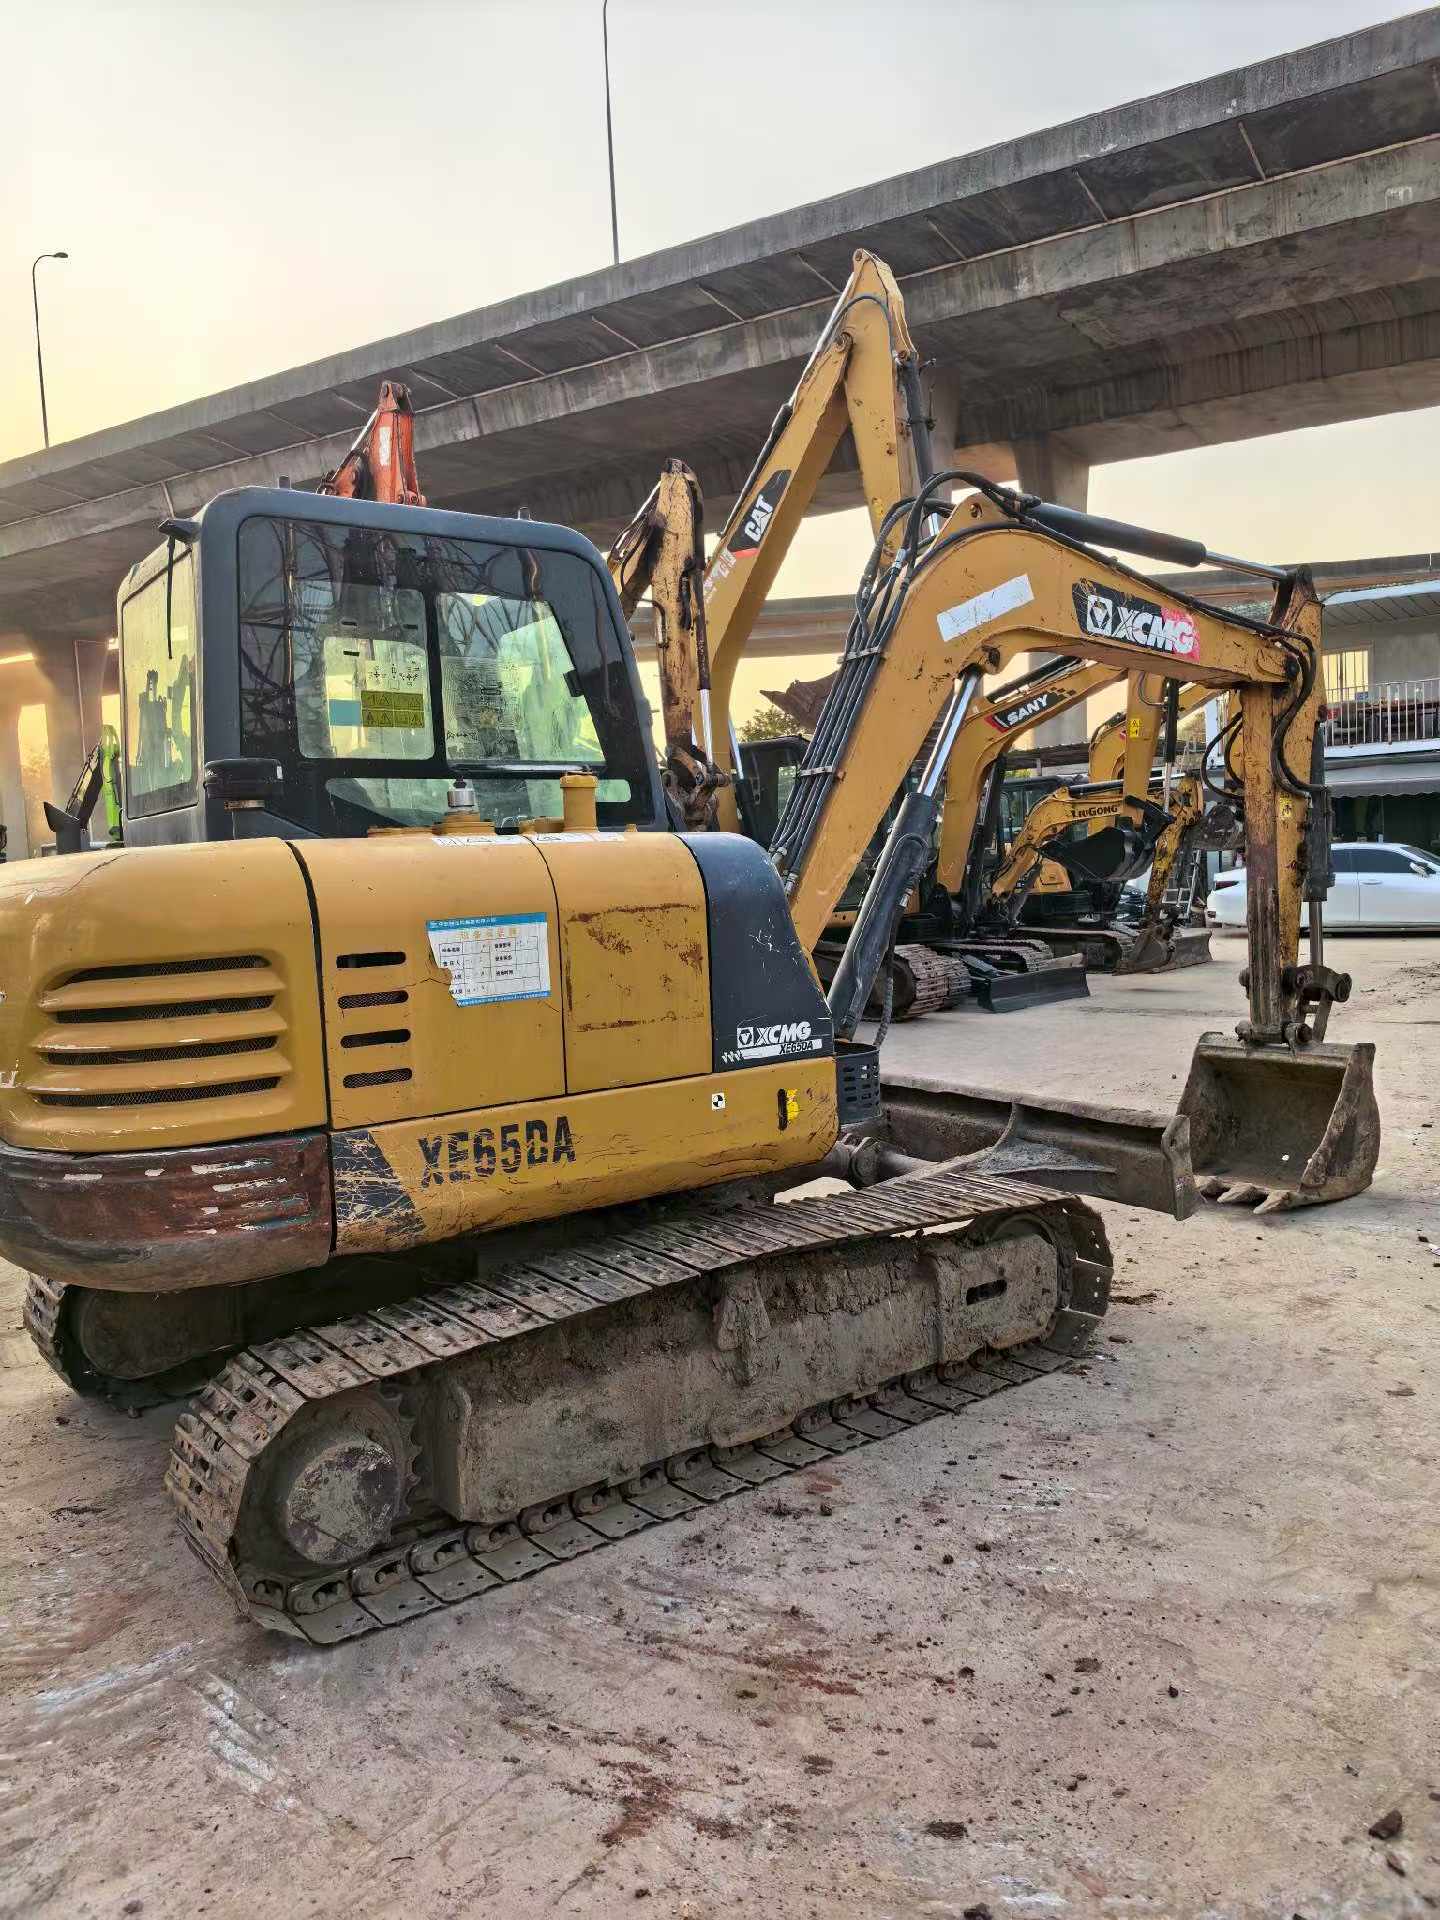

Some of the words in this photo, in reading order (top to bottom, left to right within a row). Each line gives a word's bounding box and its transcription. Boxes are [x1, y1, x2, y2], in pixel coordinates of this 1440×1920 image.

[744, 494, 774, 542] CAT
[1111, 605, 1195, 654] XCMG
[1006, 693, 1051, 726] SANY
[754, 1021, 812, 1046] XCMG
[779, 1040, 814, 1054] XE65DA
[417, 1115, 577, 1189] XE65DA
